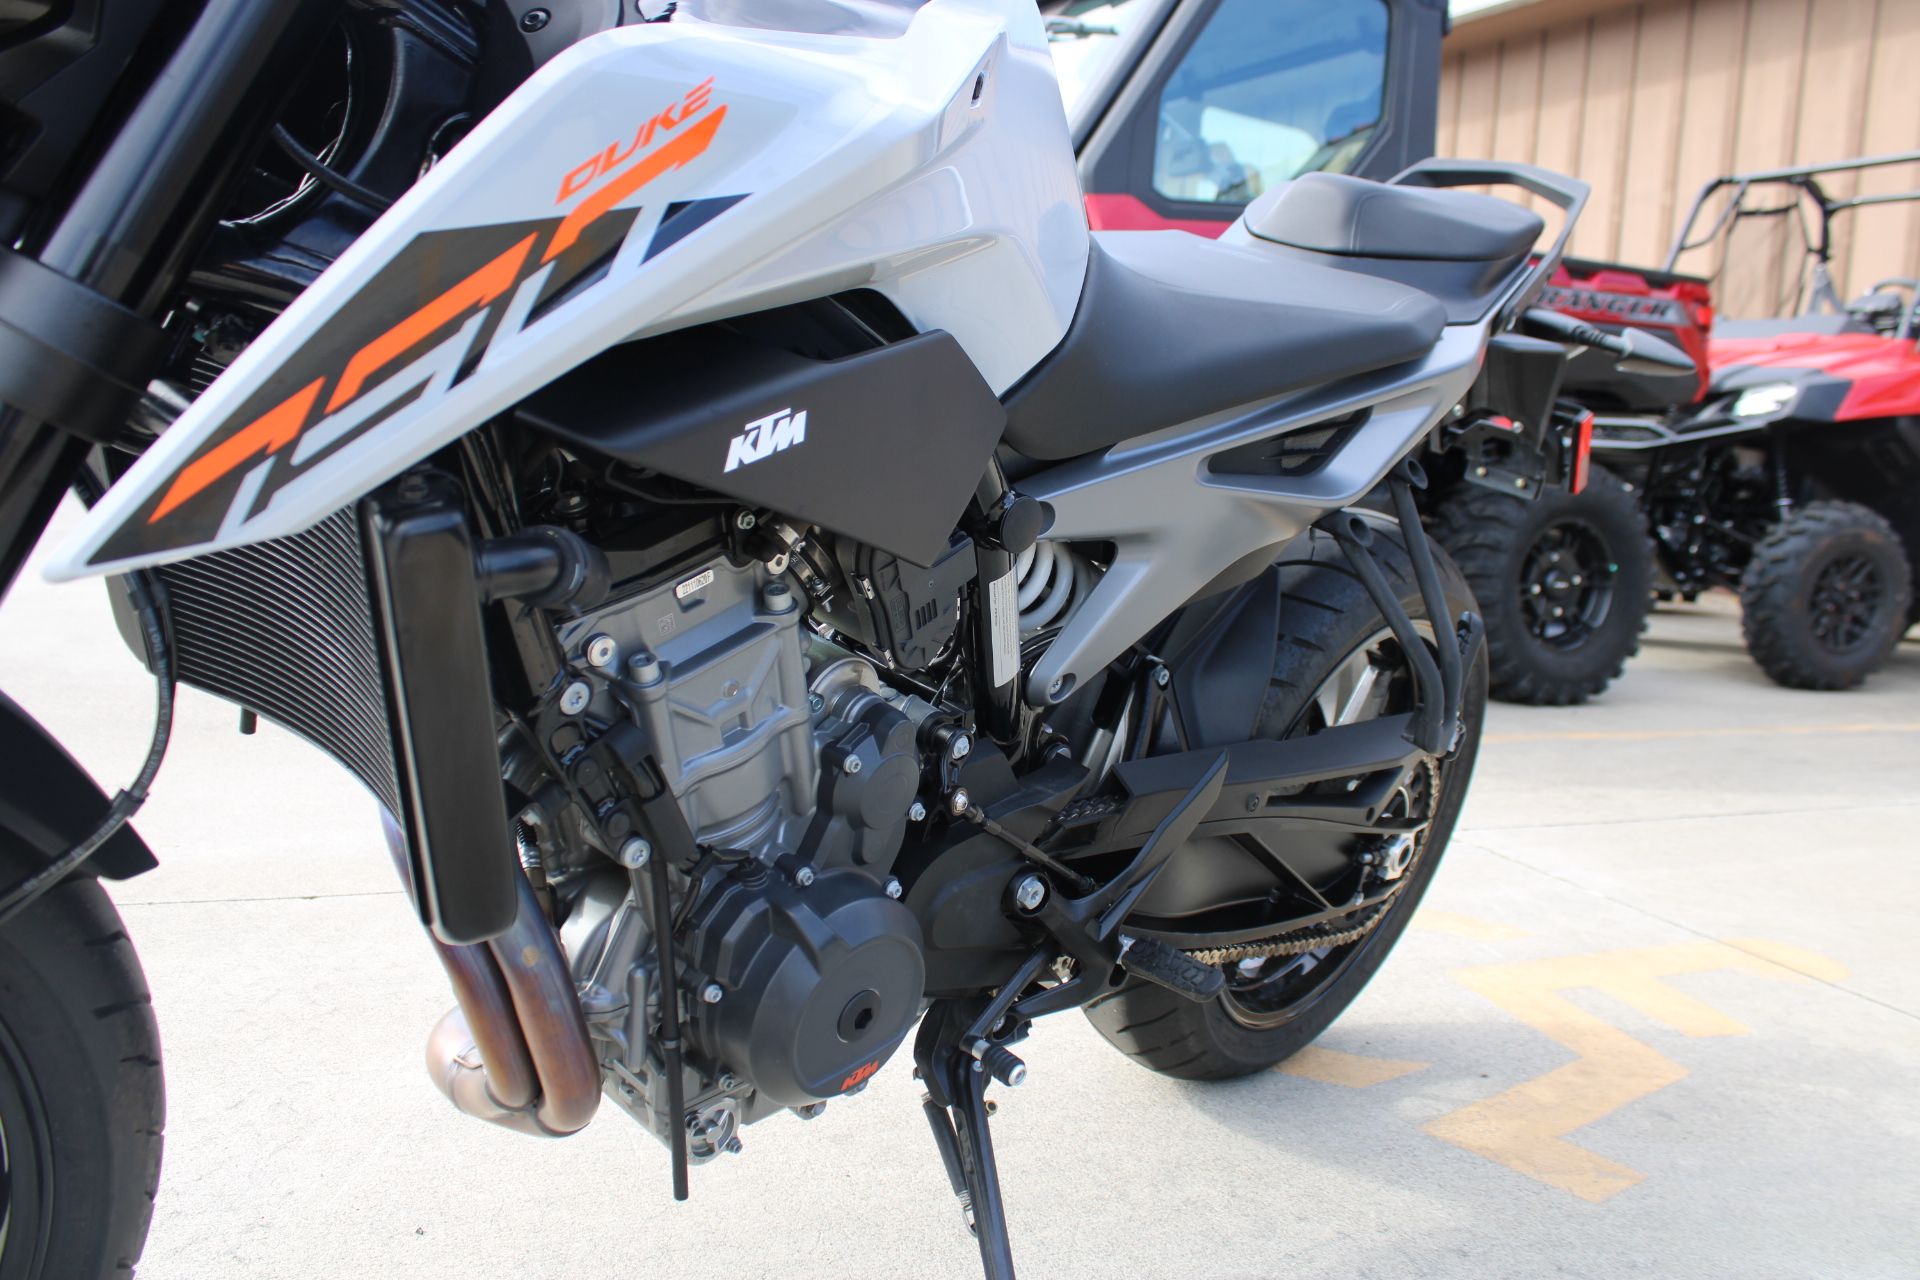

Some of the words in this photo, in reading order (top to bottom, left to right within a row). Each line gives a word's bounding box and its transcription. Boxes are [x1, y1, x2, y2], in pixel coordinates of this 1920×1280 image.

[555, 75, 716, 206] DUKE
[1536, 287, 1671, 318] RANGER
[723, 407, 808, 474] KTM
[840, 1060, 879, 1092] KTM
